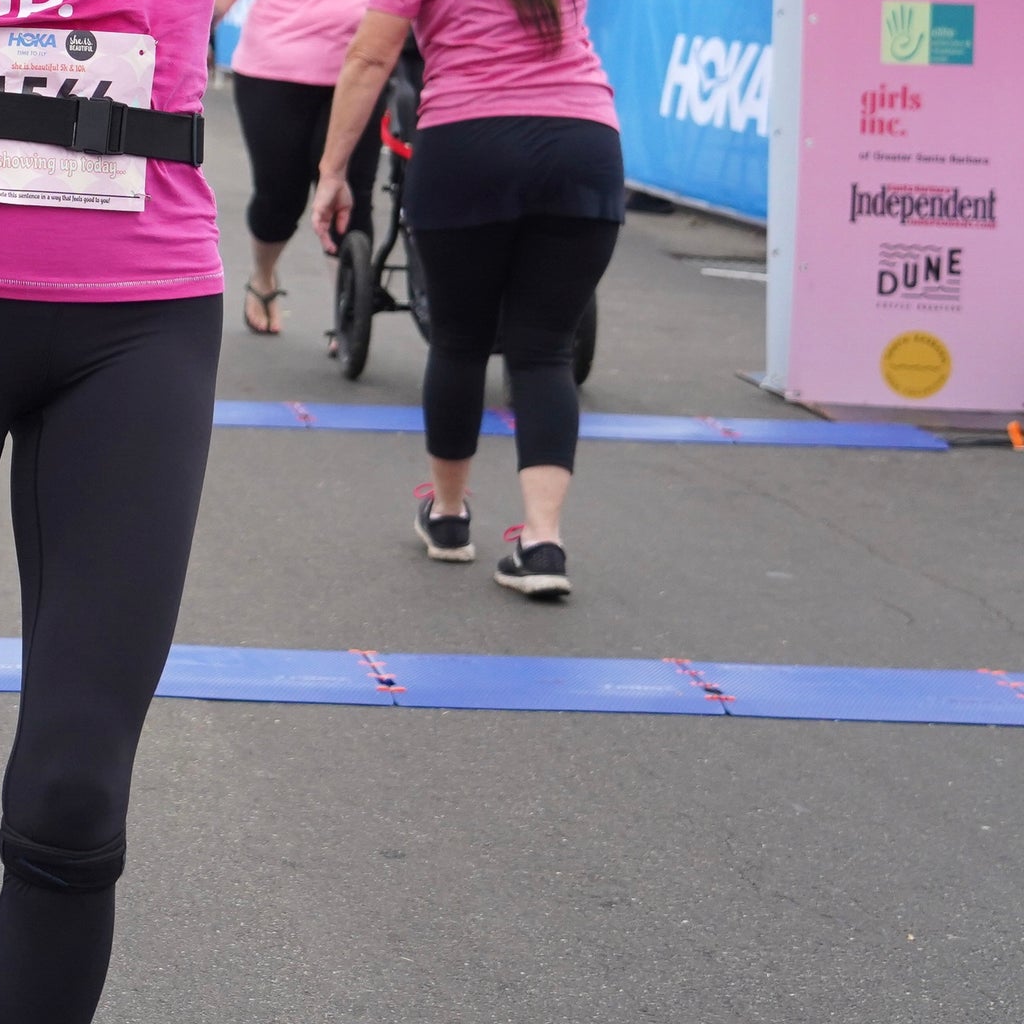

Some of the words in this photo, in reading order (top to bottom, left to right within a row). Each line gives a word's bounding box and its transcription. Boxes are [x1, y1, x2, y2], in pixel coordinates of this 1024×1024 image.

[7, 32, 57, 48] HOKA
[69, 44, 94, 53] BEAUTIFUL
[11, 62, 22, 70] she
[31, 62, 59, 72] beautiful
[659, 32, 773, 137] HOKA
[861, 83, 922, 114] girls
[860, 116, 908, 137] inc.
[59, 159, 77, 177] up
[18, 192, 40, 200] sentence
[71, 194, 83, 203] feels
[849, 182, 996, 225] Independent
[878, 248, 962, 296] DUNE
